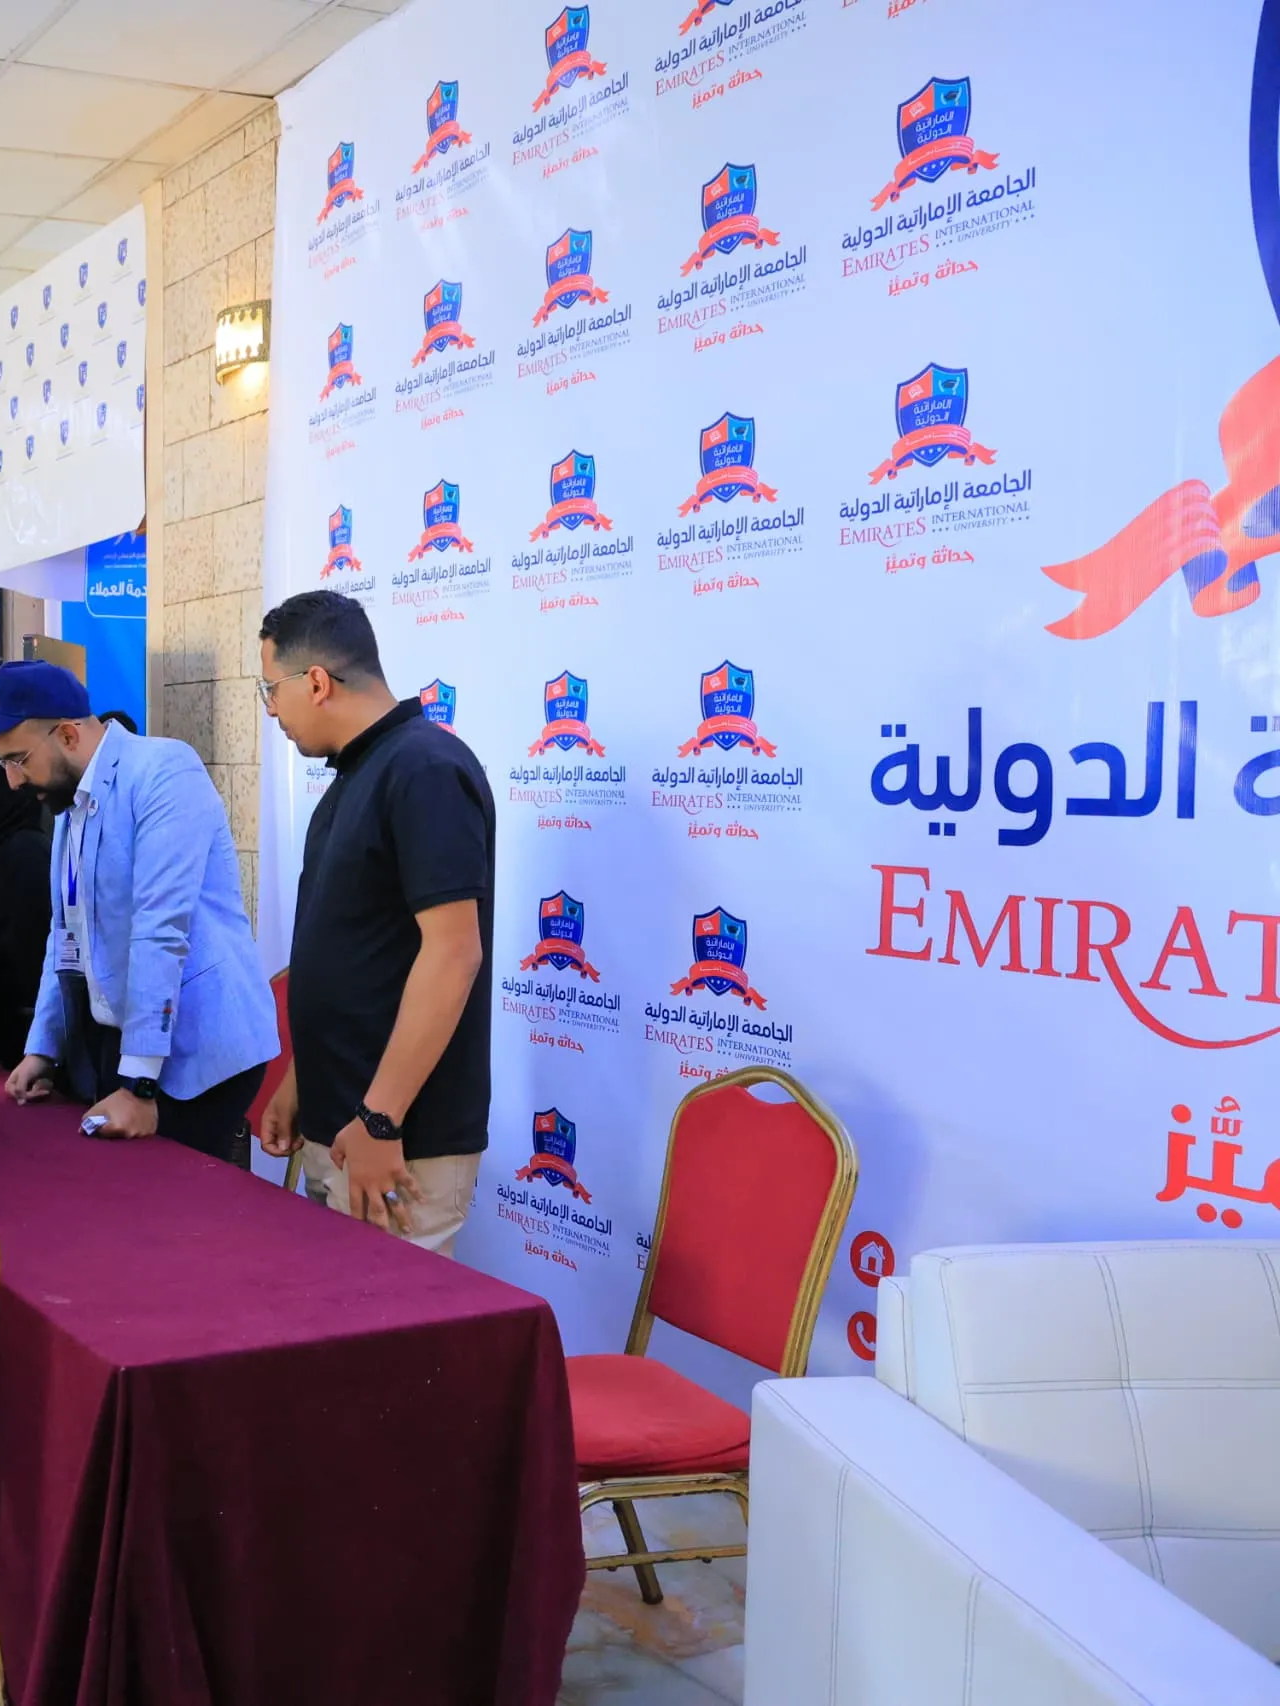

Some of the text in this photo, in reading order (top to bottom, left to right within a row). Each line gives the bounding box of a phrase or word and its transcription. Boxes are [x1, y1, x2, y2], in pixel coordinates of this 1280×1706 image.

[699, 11, 750, 51] الإماراتية
[655, 11, 805, 96] EMIRATES INTERNATIONAL
[655, 38, 695, 72] الدولية
[728, 69, 762, 89] حداثة
[842, 166, 1034, 251] الجامعة الإماراتية الدولية
[842, 199, 1033, 276] EMIRATES INTERNATIONAL
[957, 219, 1011, 241] UNIVERSITY
[658, 244, 806, 311] الجامعة الإماراتية الدولية
[935, 258, 978, 279] حداثة
[658, 273, 805, 333] EMIRATES INTERNATIONAL
[730, 321, 763, 339] حداثة
[517, 348, 568, 376] EMIRATES
[839, 468, 1031, 521] الجامعة الإماراتية الدولية
[657, 506, 803, 549] الجامعة الإماراتية الدولية
[839, 501, 1028, 547] EMIRATES INTERNATIONAL
[954, 517, 1007, 530] UNIVERSITY
[657, 534, 801, 572] EMIRATES INTERNATIONAL
[931, 545, 974, 564] حداثة
[89, 580, 125, 597] العملاء
[509, 568, 567, 592] EMIRATES
[727, 571, 760, 588] حداثة
[653, 766, 802, 790] الجامعة الإماراتية الدولية
[870, 700, 1198, 847] الدولية
[509, 787, 563, 808] EMIRATES
[652, 791, 800, 814] EMIRATES INTERNATIONAL
[725, 820, 758, 840] حداثة
[865, 864, 1280, 1050] EMIRAT
[501, 997, 555, 1022] EMIRATES
[645, 1002, 793, 1043] الجامعة الإماراتية الدولية
[644, 1024, 790, 1059] EMIRATES INTERNATIONAL
[497, 1203, 549, 1233] EMIRATES
